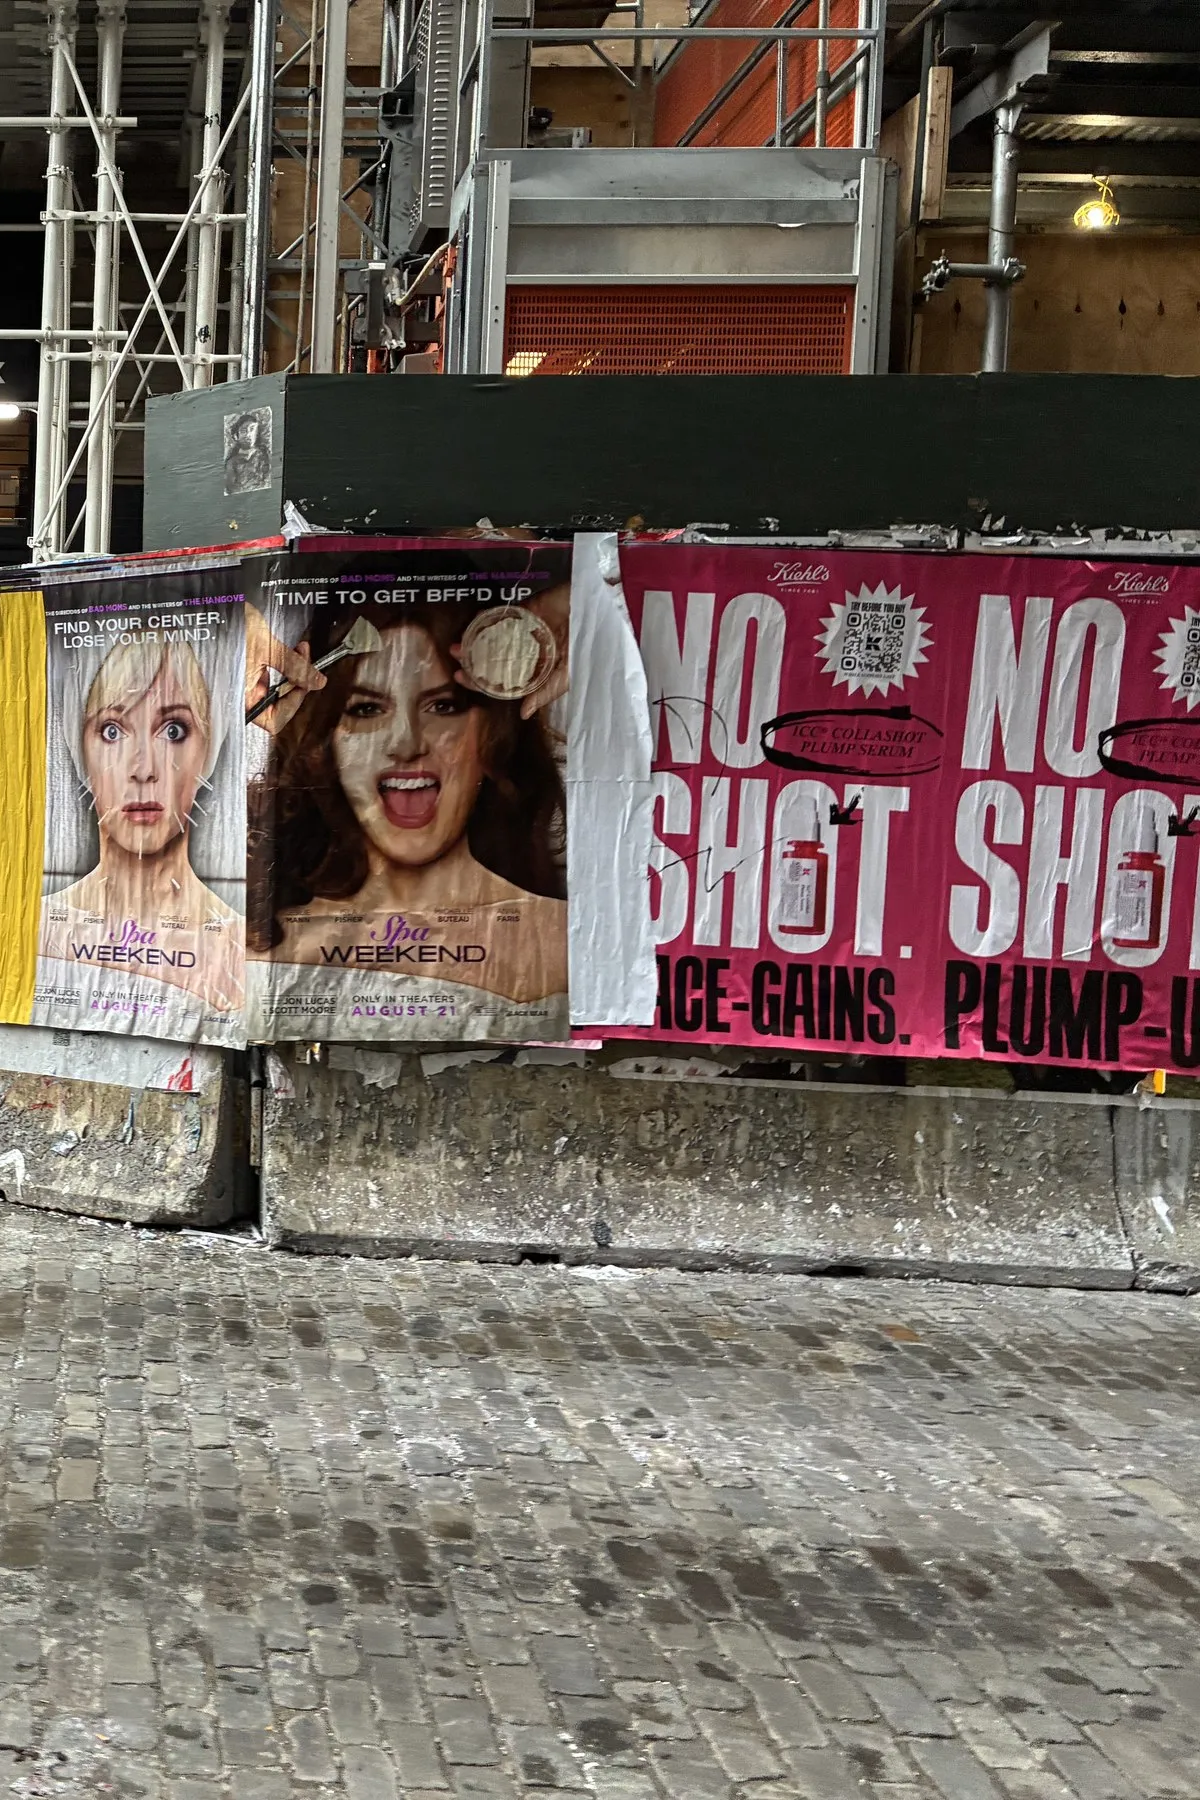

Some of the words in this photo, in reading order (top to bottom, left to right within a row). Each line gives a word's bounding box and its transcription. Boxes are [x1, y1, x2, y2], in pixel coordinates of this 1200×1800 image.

[291, 577, 329, 585] DIRECTORS
[340, 575, 362, 583] BAD
[427, 574, 457, 582] WRITERS
[767, 562, 829, 582] Kiehl's
[1108, 572, 1169, 592] Kiehl's
[88, 605, 104, 613] BAD
[106, 603, 128, 612] MOMS
[184, 598, 200, 606] THE
[202, 594, 246, 605] HANGOVE
[275, 591, 329, 606] TIME
[335, 590, 367, 604] TO
[374, 589, 420, 604] GET
[426, 587, 492, 602] BFF'D
[501, 587, 532, 600] UP
[54, 621, 90, 635] FIND
[95, 617, 142, 632] YOUR
[147, 611, 226, 629] CENTER.
[63, 635, 105, 649] LOSE
[109, 631, 158, 646] YOUR
[163, 628, 216, 643] MIND.
[640, 591, 786, 769] NO
[961, 594, 1126, 777] NO
[832, 727, 927, 743] COLLASHOT
[801, 741, 856, 755] PLUMP
[858, 744, 915, 757] SERUM
[648, 771, 912, 958] SHOT.
[949, 780, 1200, 970] SHO
[109, 919, 157, 952] Spa
[370, 914, 431, 952] Spa
[72, 943, 196, 968] WEEKEND
[319, 945, 487, 963] WEEKEND
[58, 988, 80, 997] LUCAS
[92, 990, 116, 999] ONLY
[117, 991, 126, 1000] IN
[128, 992, 169, 1004] THEATERS
[283, 997, 302, 1005] JON
[305, 997, 336, 1005] LUCAS
[352, 995, 381, 1004] ONLY
[385, 995, 397, 1003] IN
[401, 995, 455, 1003] THEATERS
[655, 954, 911, 1046] ACE-GAINS.
[90, 1000, 148, 1014] AUGUST
[351, 1006, 428, 1017] AUGUST
[439, 1006, 456, 1016] 21
